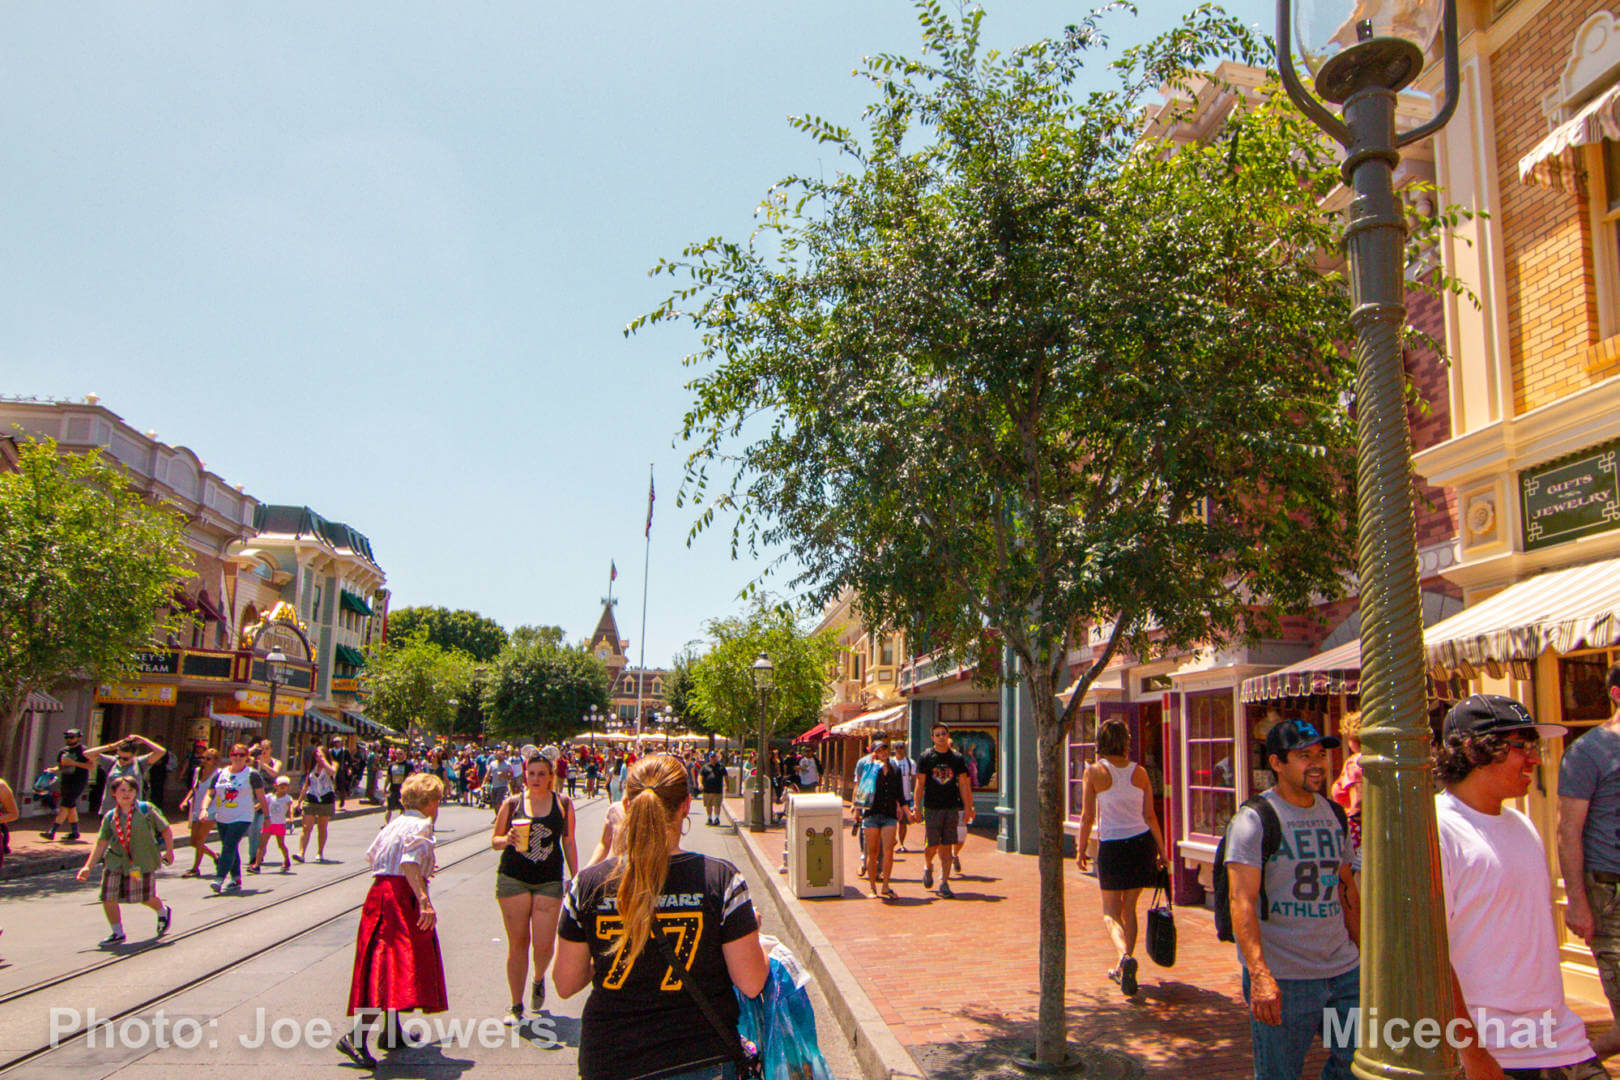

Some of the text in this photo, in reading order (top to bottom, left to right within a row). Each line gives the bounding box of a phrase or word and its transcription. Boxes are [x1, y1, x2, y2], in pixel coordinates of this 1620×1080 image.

[1547, 474, 1593, 495] GIFTS
[1531, 489, 1611, 519] JEWELRY
[140, 664, 169, 673] TEAM
[1292, 861, 1340, 902] 87
[655, 893, 704, 908] WARS
[596, 911, 704, 991] 77
